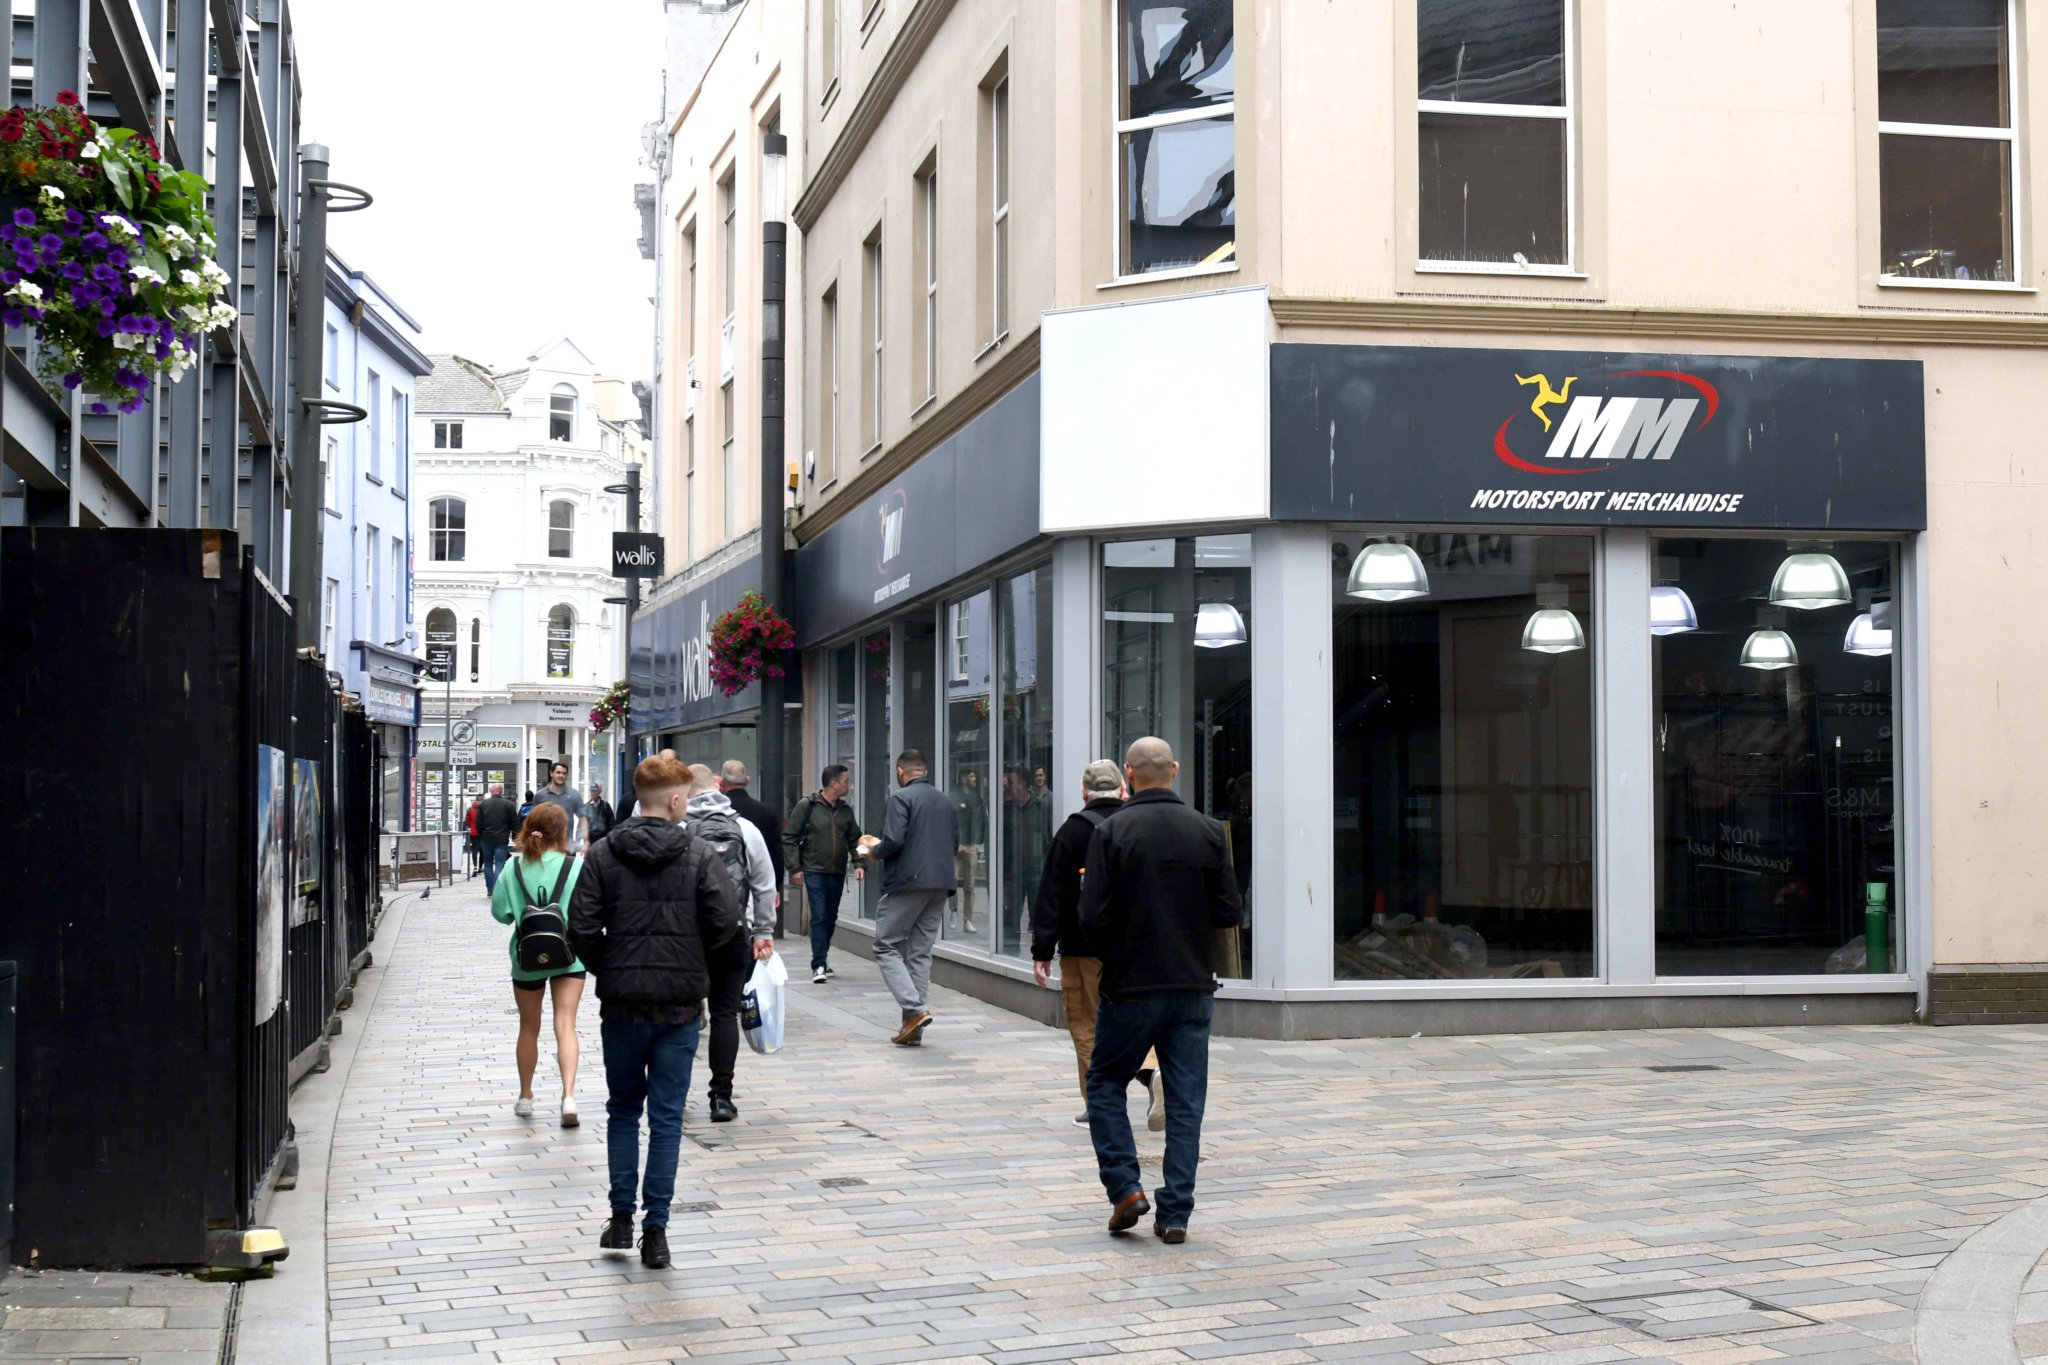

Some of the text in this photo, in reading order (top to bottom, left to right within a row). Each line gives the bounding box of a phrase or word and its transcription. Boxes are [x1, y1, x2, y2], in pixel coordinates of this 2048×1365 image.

[1545, 396, 1700, 460] MM
[1470, 489, 1743, 513] MOTORSPORT MERCHANDISE
[615, 545, 656, 566] wallis
